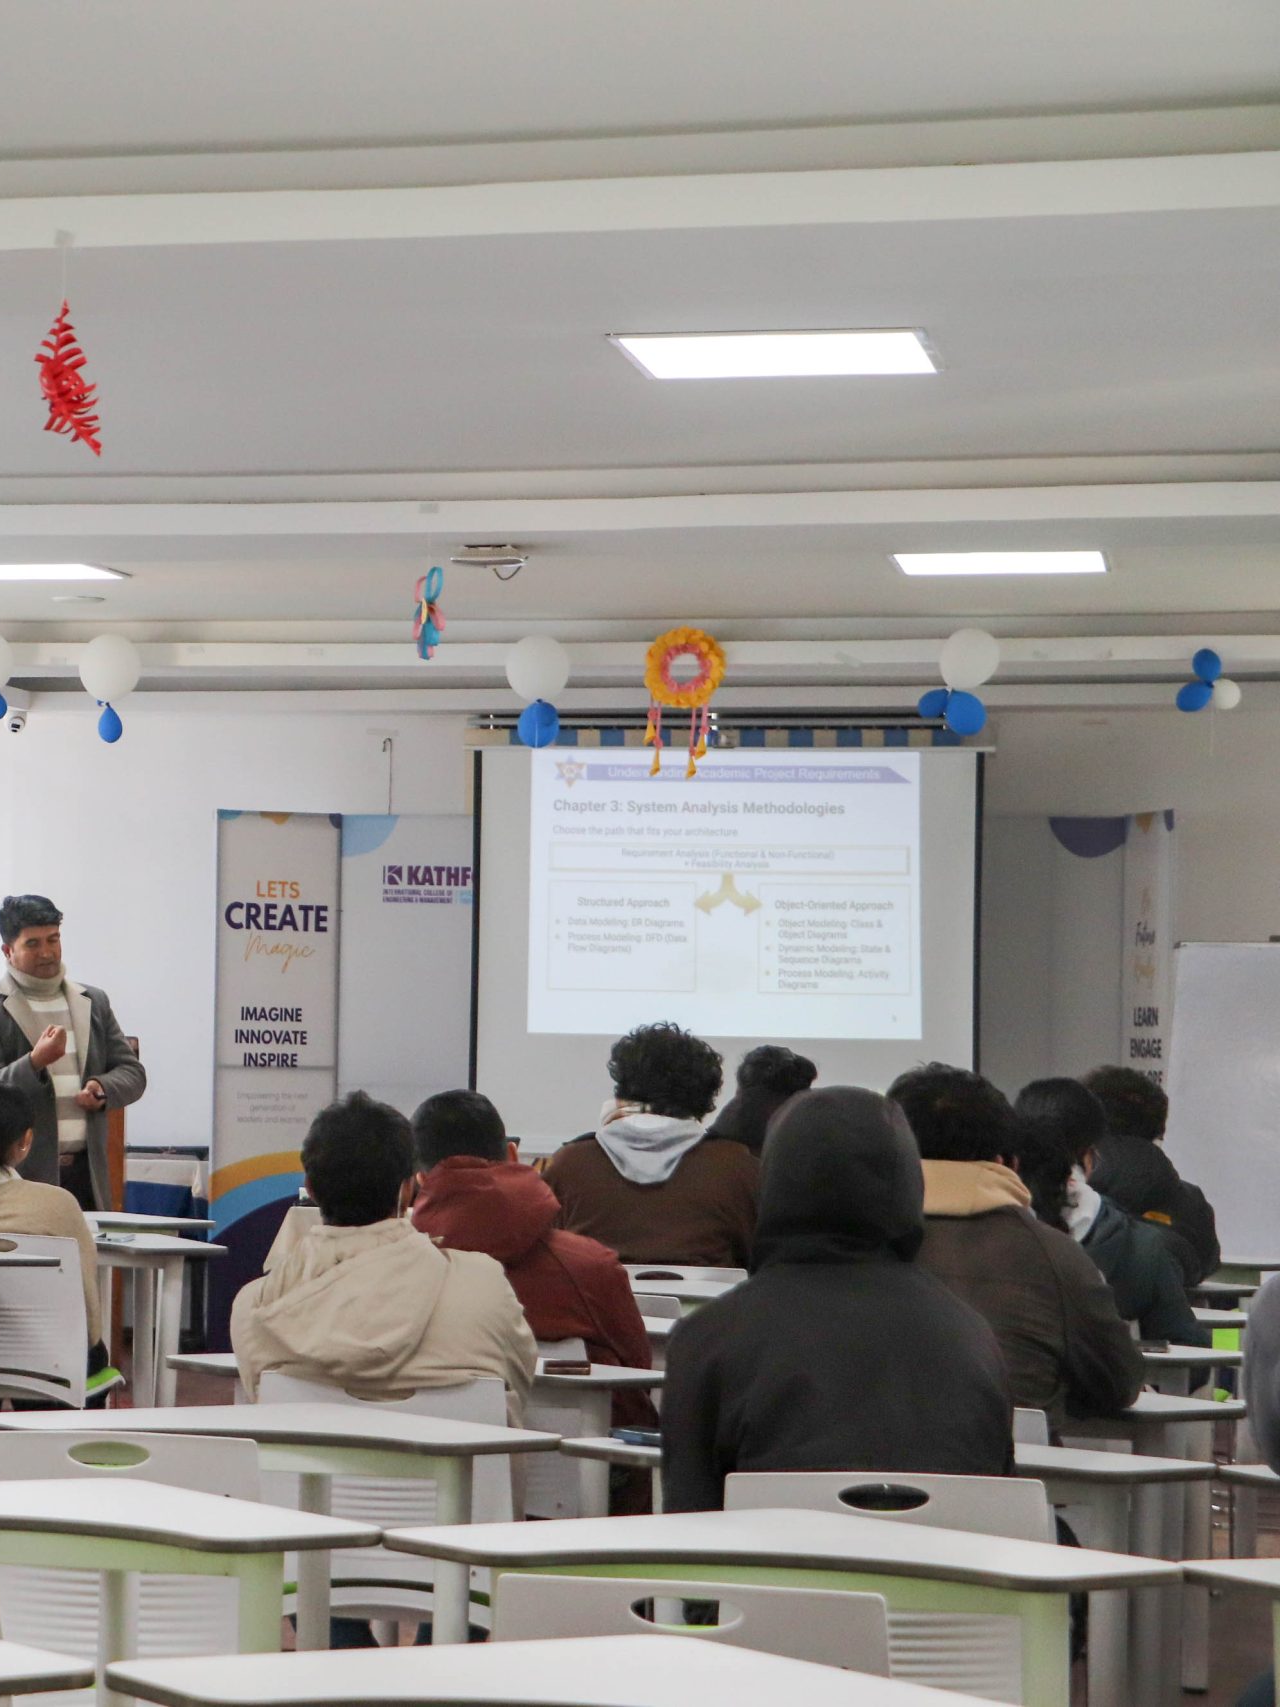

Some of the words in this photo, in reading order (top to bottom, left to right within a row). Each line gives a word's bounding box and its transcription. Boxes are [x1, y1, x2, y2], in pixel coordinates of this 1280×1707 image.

[754, 767, 795, 781] Project
[799, 768, 880, 781] Requirements
[553, 799, 606, 814] Chapter
[610, 800, 623, 812] 3:
[627, 800, 677, 815] System
[681, 801, 738, 815] Analysis
[743, 802, 845, 817] Methodologies
[552, 824, 586, 835] Choose
[588, 825, 603, 835] the
[605, 825, 625, 837] path
[626, 825, 644, 835] that
[646, 826, 660, 836] fits
[663, 828, 683, 838] your
[684, 827, 738, 837] architecture
[621, 848, 673, 858] Requirement
[675, 848, 709, 859] Analysis
[735, 860, 769, 870] Analysis
[407, 865, 473, 886] KATHF
[256, 880, 300, 899] LETS
[577, 897, 624, 907] Structured
[627, 897, 670, 909] Approach
[774, 900, 847, 911] Object-Oriented
[849, 901, 894, 912] Approach
[224, 901, 328, 932] CREATE
[568, 917, 587, 925] Data
[778, 919, 805, 930] Object
[568, 932, 601, 941] Process
[778, 930, 805, 941] Object
[807, 931, 848, 941] Diagrams
[244, 932, 316, 974] Magic
[568, 943, 587, 952] Flow
[778, 945, 814, 954] Dynamic
[778, 956, 819, 966] Sequence
[778, 969, 812, 978] Process
[858, 970, 889, 980] Activity
[778, 980, 819, 991] Diagrams
[240, 1006, 302, 1022] IMAGINE
[1133, 1007, 1159, 1027] LEARN
[234, 1029, 307, 1045] INNOVATE
[1130, 1038, 1162, 1059] ENGAGE
[243, 1052, 298, 1067] INSPIRE
